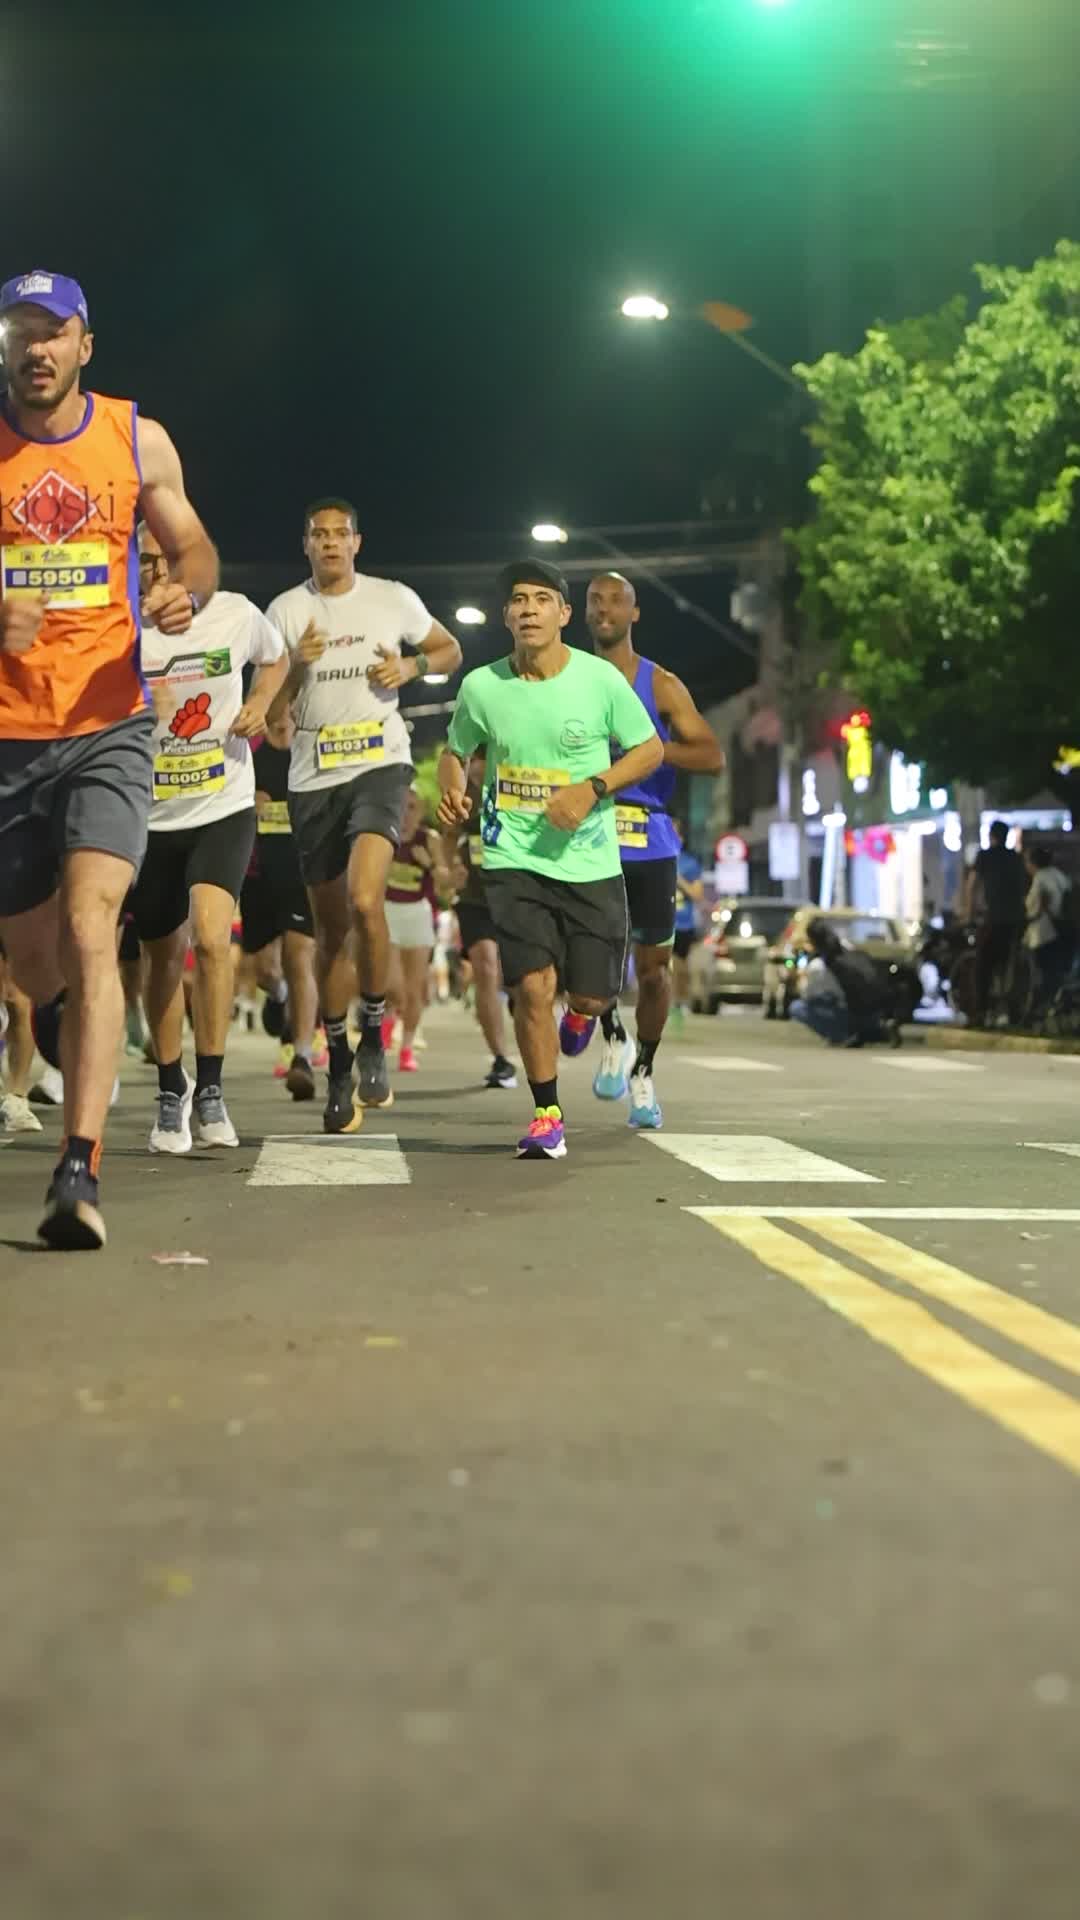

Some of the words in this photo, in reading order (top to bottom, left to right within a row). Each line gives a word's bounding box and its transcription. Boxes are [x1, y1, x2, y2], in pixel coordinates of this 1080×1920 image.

[28, 569, 87, 586] 5950
[334, 739, 368, 754] 6031
[169, 768, 211, 785] 6002
[512, 783, 551, 799] 6696
